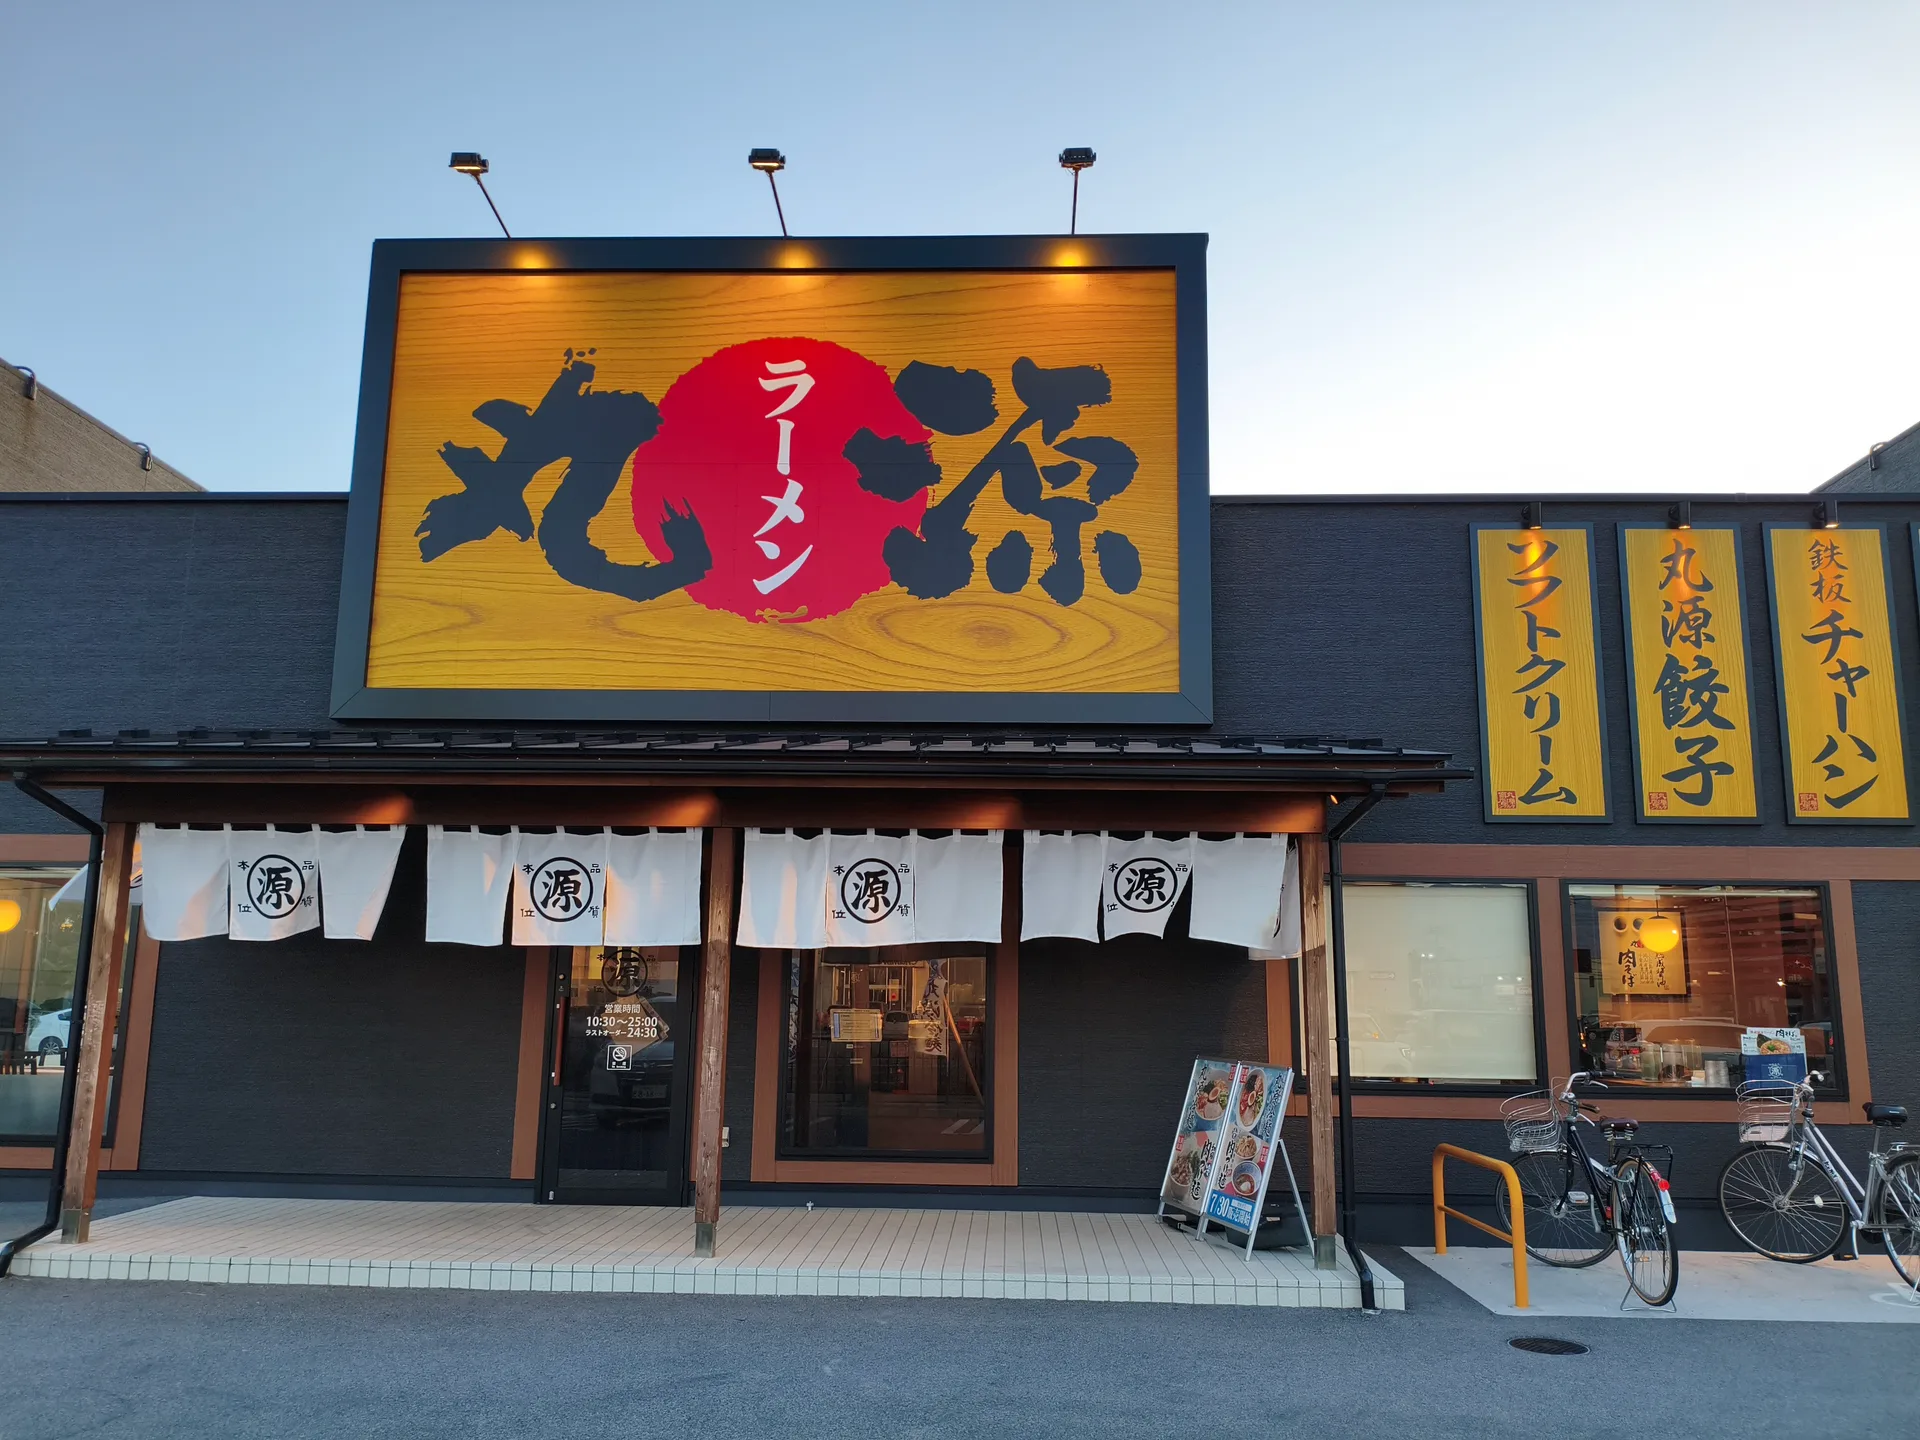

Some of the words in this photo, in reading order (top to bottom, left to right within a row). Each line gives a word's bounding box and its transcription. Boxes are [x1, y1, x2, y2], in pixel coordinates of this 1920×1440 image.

[753, 359, 816, 595] ラーメン
[1506, 539, 1578, 805] ソフトクリーム
[1653, 538, 1737, 807] 丸源餃子
[1801, 538, 1880, 809] 鉄板チャーハン
[256, 866, 295, 910] 源
[541, 869, 582, 912] 源
[851, 869, 890, 913] 源
[1123, 867, 1166, 904] 源
[1618, 949, 1637, 987] 肉そば
[605, 1004, 640, 1013] 営業時間
